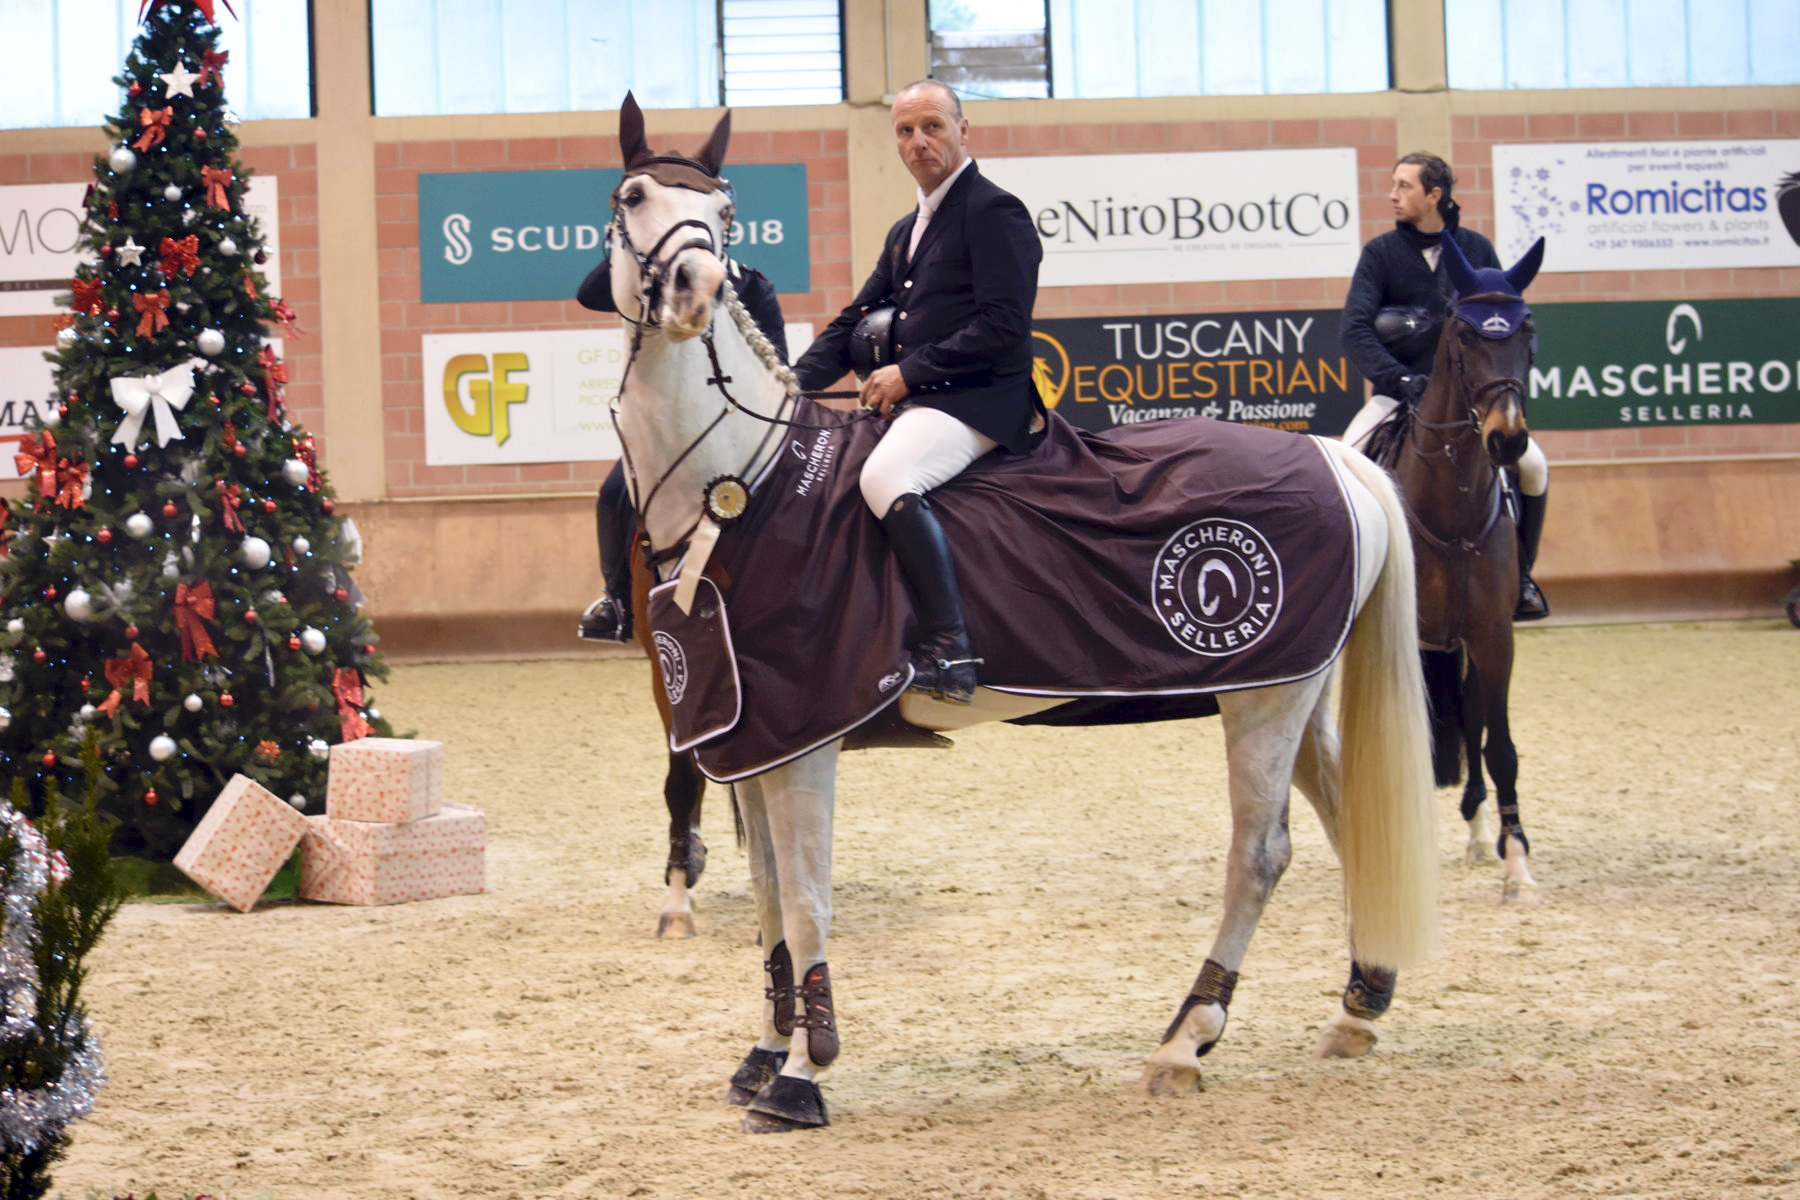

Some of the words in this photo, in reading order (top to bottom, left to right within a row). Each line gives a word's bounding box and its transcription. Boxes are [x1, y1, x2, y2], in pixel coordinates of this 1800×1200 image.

[1586, 180, 1767, 215] Romicitas
[491, 224, 610, 252] SCUD
[1587, 220, 1648, 234] artificial
[1652, 219, 1703, 232] flowers
[1709, 219, 1719, 231] &
[1724, 218, 1770, 232] plants
[1103, 317, 1314, 360] TUSCANY
[1074, 356, 1348, 405] EQUESTRIAN
[1529, 360, 1800, 399] MASCHERO
[443, 352, 530, 447] GF
[1202, 400, 1223, 420] &
[1226, 399, 1316, 421] Passione
[1620, 404, 1753, 421] SELLERIA
[1160, 526, 1271, 590] MASCHERONI
[1170, 603, 1272, 648] SELLERIA
